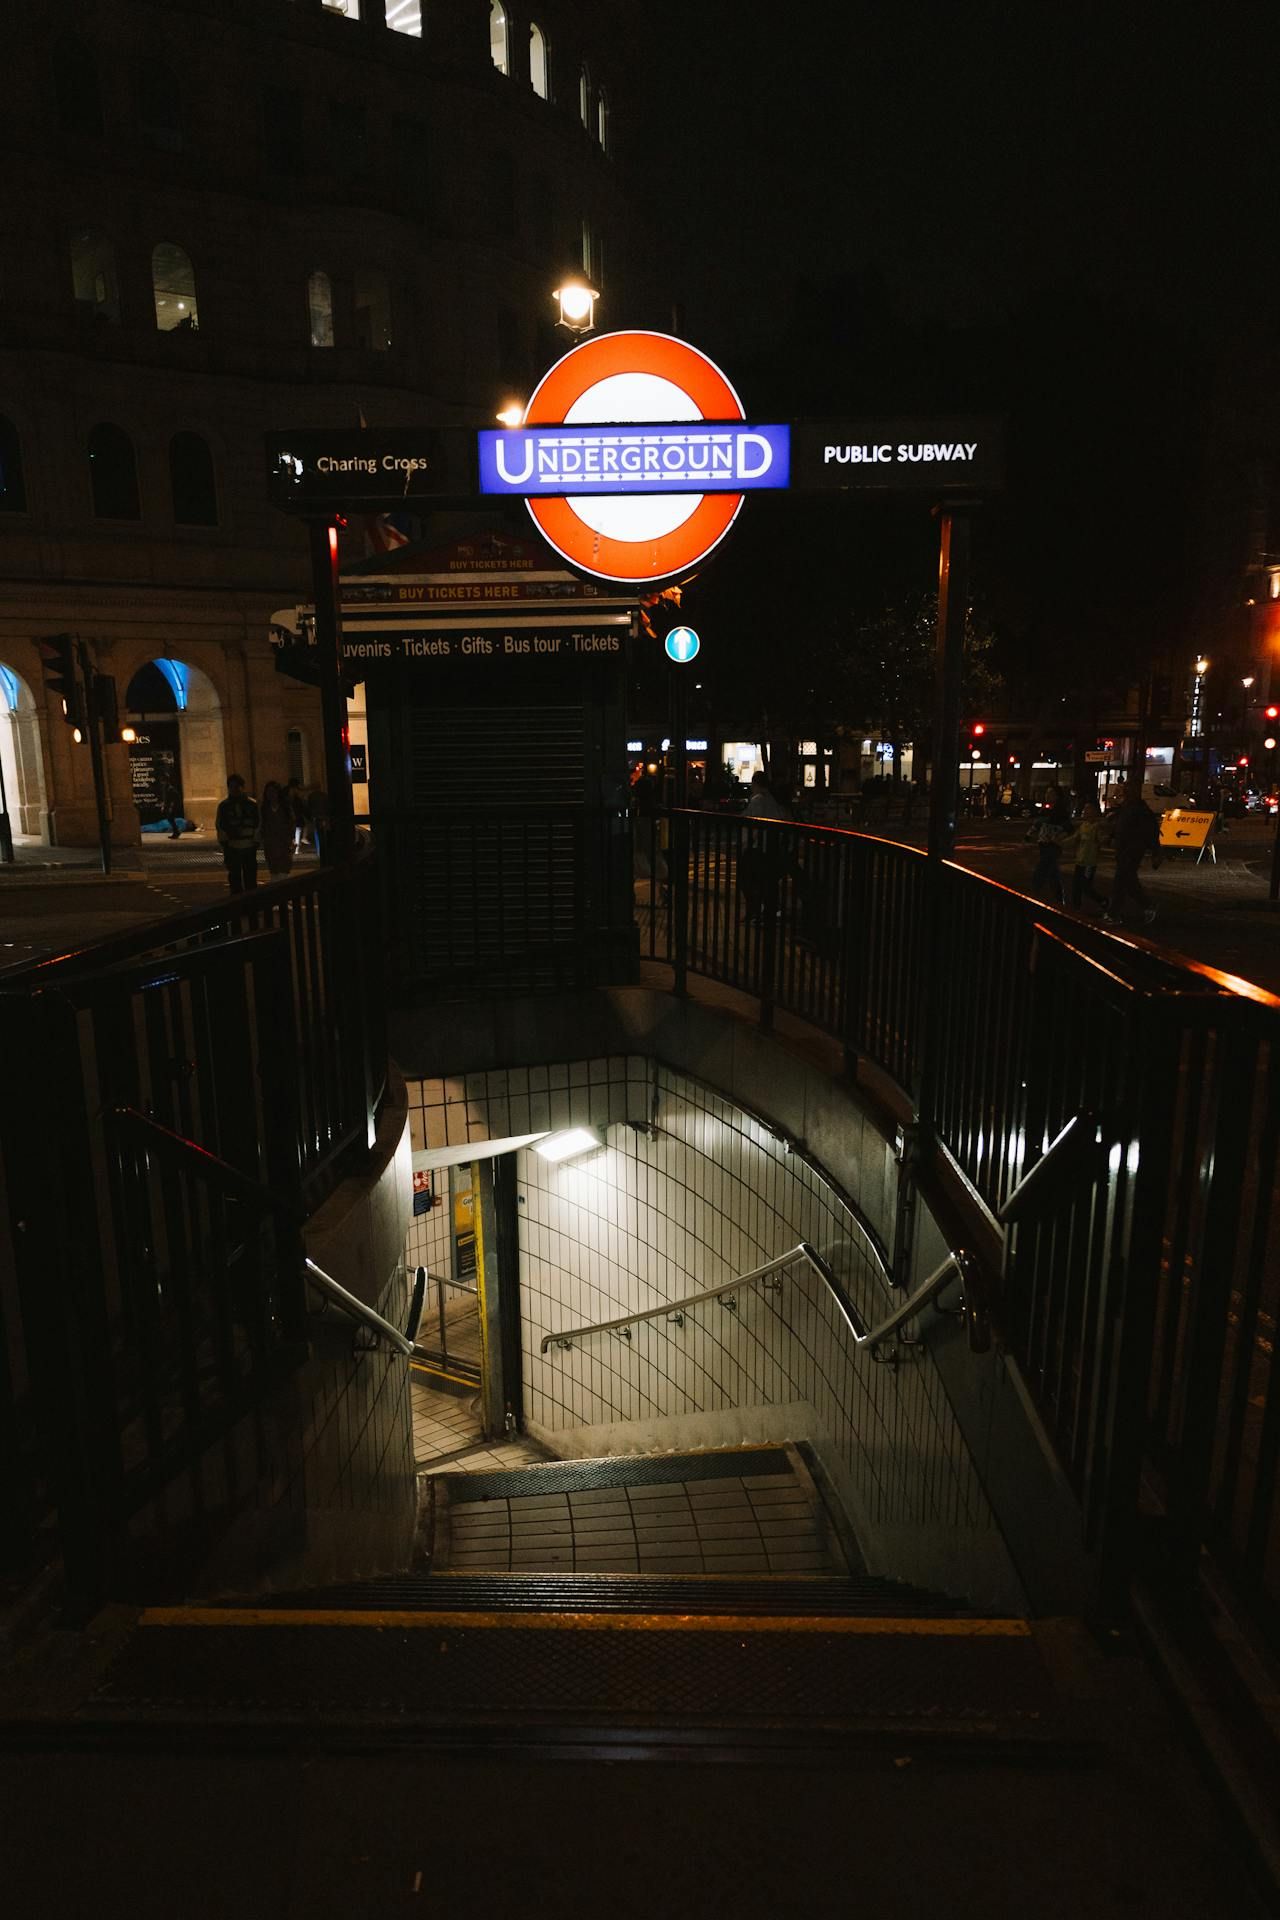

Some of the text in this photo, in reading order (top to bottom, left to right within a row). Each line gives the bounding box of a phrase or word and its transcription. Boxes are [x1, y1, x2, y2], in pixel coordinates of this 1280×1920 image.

[495, 432, 773, 484] UNDERGROUND
[823, 442, 978, 465] PUBLIC SUBWAY
[316, 455, 428, 475] Charing Cross
[449, 559, 534, 570] BUY TICKETS HERE
[399, 587, 424, 600] BUY
[427, 586, 481, 599] TICKETS
[484, 585, 519, 598] HERE
[402, 637, 451, 657] Tickets
[461, 636, 494, 655] Gifts
[504, 635, 530, 654] Bus
[533, 636, 562, 654] tour
[571, 633, 620, 653] Tickets
